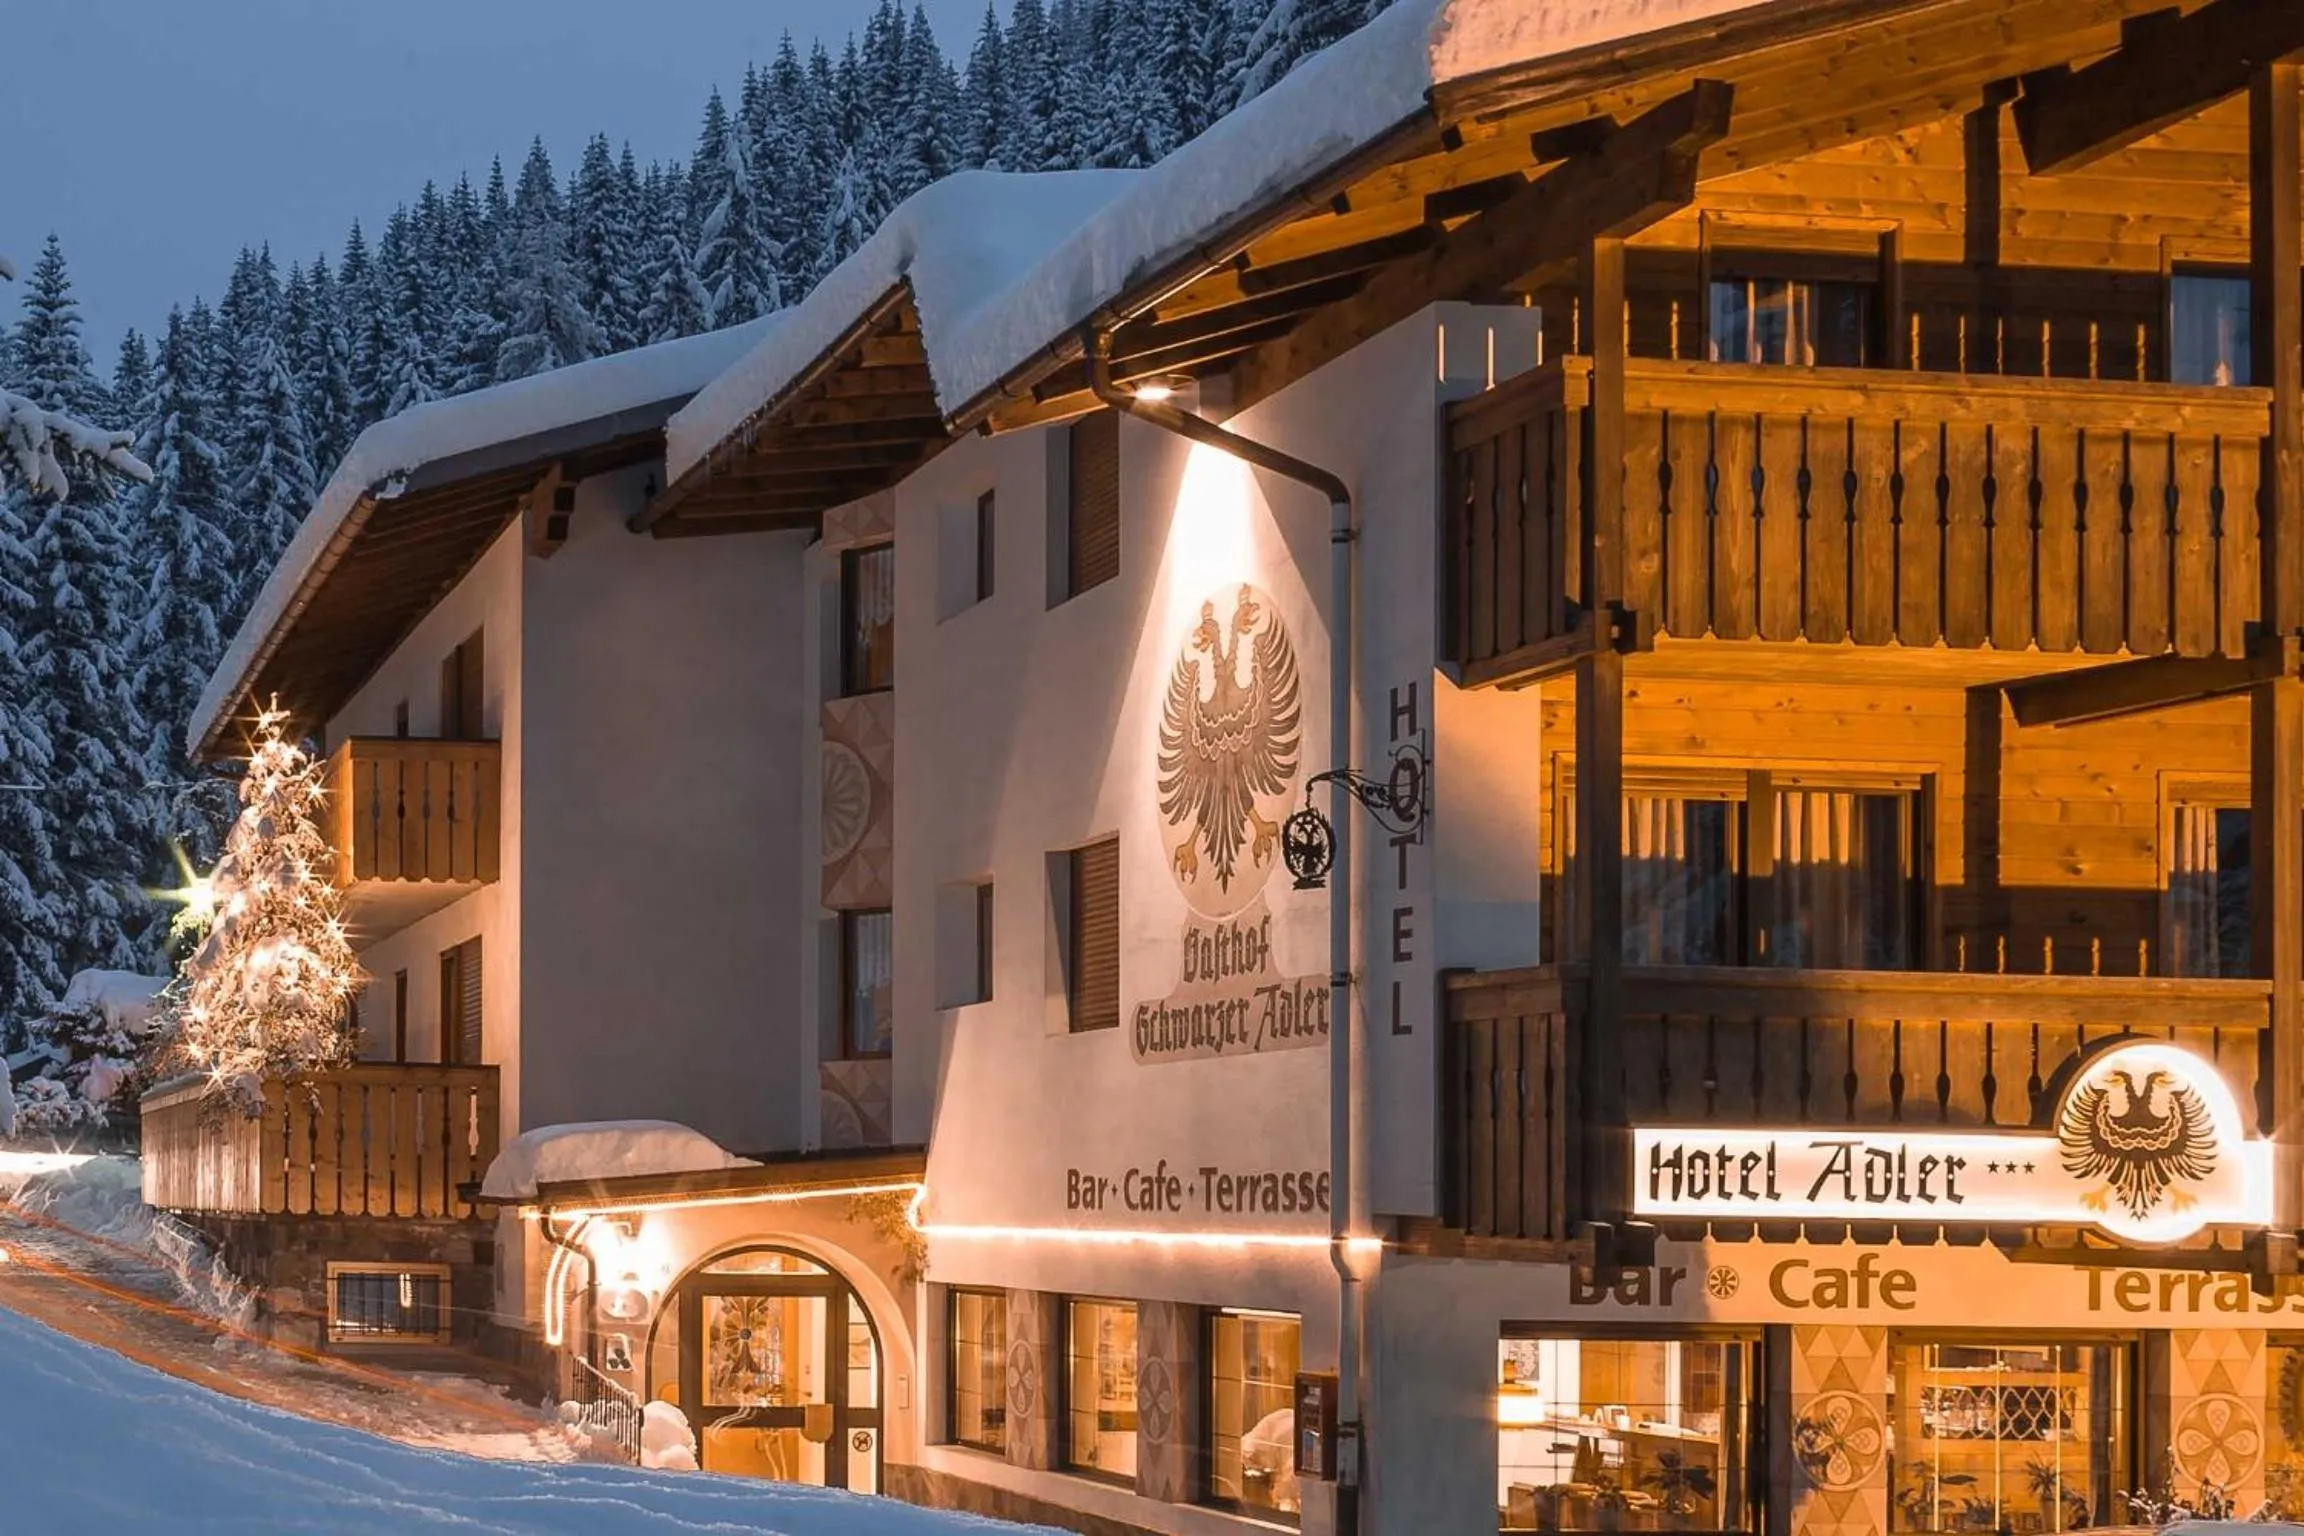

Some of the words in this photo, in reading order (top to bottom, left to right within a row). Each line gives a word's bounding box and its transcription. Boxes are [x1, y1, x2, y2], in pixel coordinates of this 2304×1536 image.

[1389, 681, 1420, 1036] HOTEL
[1253, 976, 1330, 1053] Adler
[1066, 1167, 1109, 1211] Bar
[1123, 1159, 1182, 1212] Cafe
[1198, 1166, 1330, 1213] Terrasse
[1649, 1140, 1782, 1202] Hotel
[1805, 1140, 1967, 1204] Adler
[1768, 1252, 1917, 1310] Cafe
